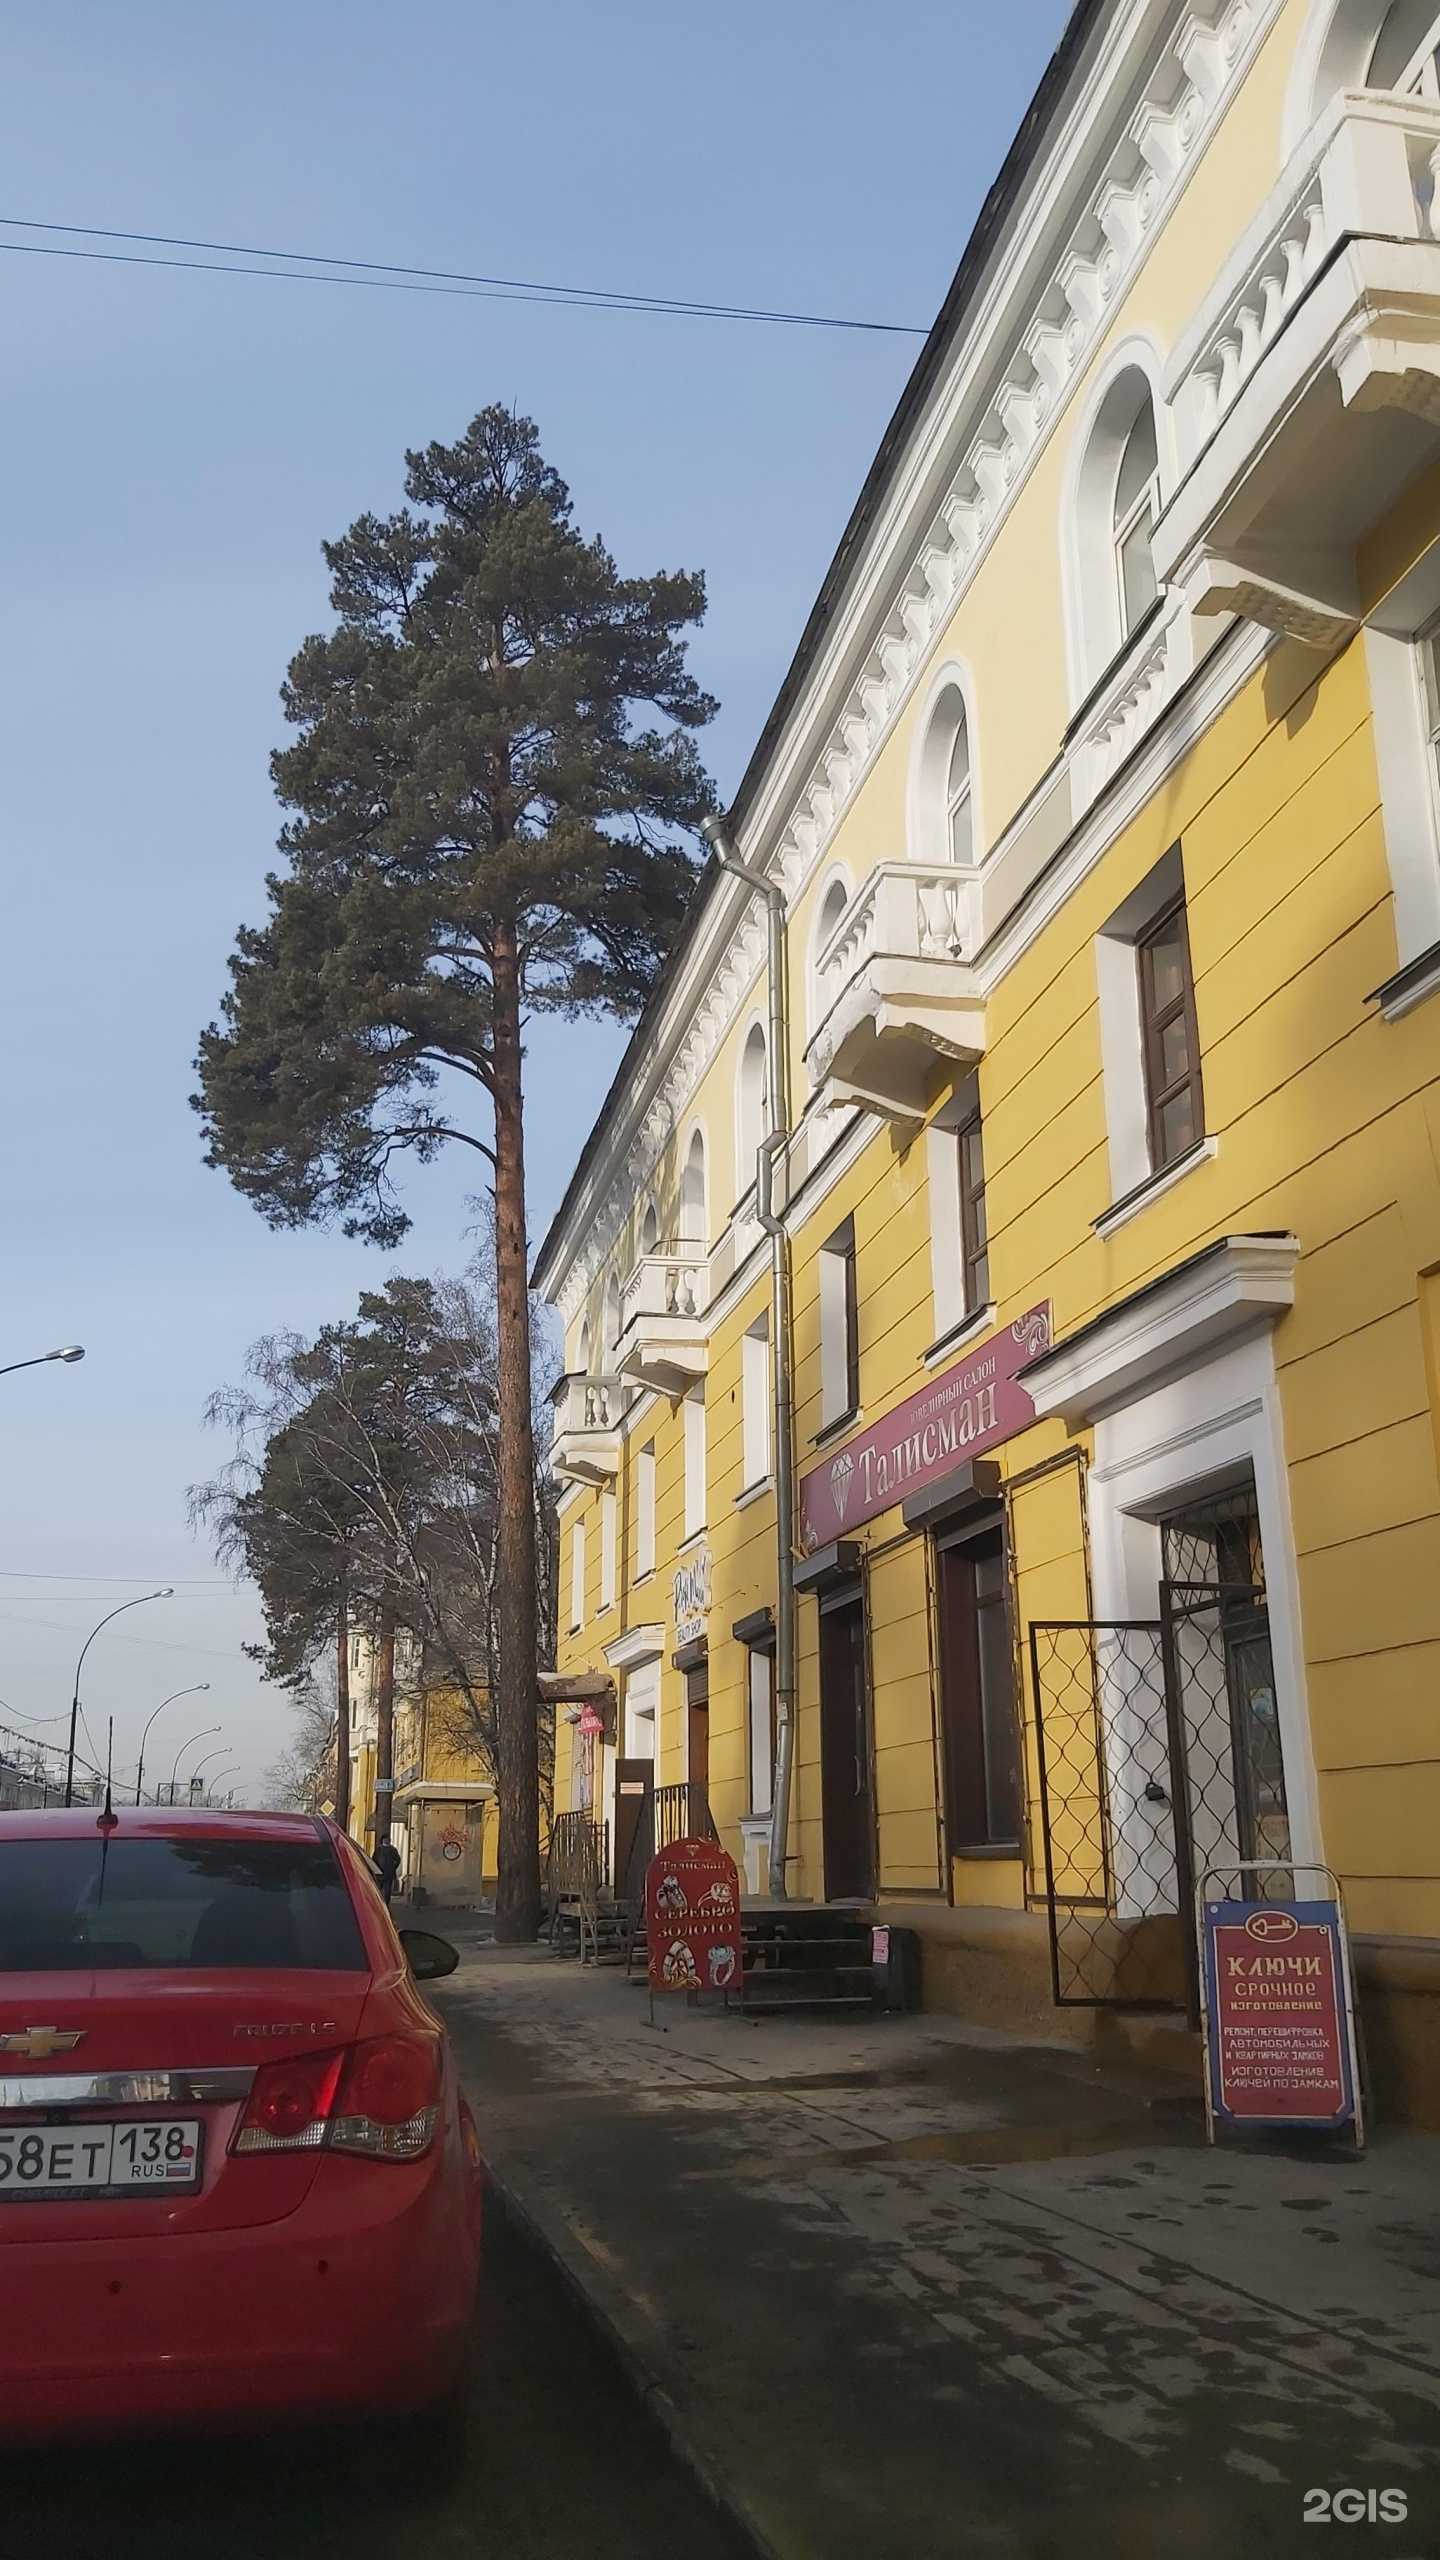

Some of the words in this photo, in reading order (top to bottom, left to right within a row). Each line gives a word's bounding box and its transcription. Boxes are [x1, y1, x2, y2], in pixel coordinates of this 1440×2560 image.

[963, 1357, 996, 1391] САЛОН
[858, 1382, 999, 1505] Талисман
[655, 1905, 735, 1919] СЕРЕБРО
[658, 1923, 733, 1937] ЗОЛОТО
[1227, 1957, 1322, 1977] КЛЮЧИ
[1229, 2039, 1330, 2049] АВТОМОБИЛЬНЫХ
[1225, 2051, 1232, 2060] И
[1231, 2066, 1325, 2076] ИЗГОТОВЛЕНИЕ
[1224, 2077, 1271, 2088] КЛЮЧЕЙ
[1273, 2079, 1289, 2088] ПО
[1291, 2079, 1339, 2089] ЗАМКАМ
[119, 2127, 185, 2163] 138
[131, 2164, 165, 2178] RUS
